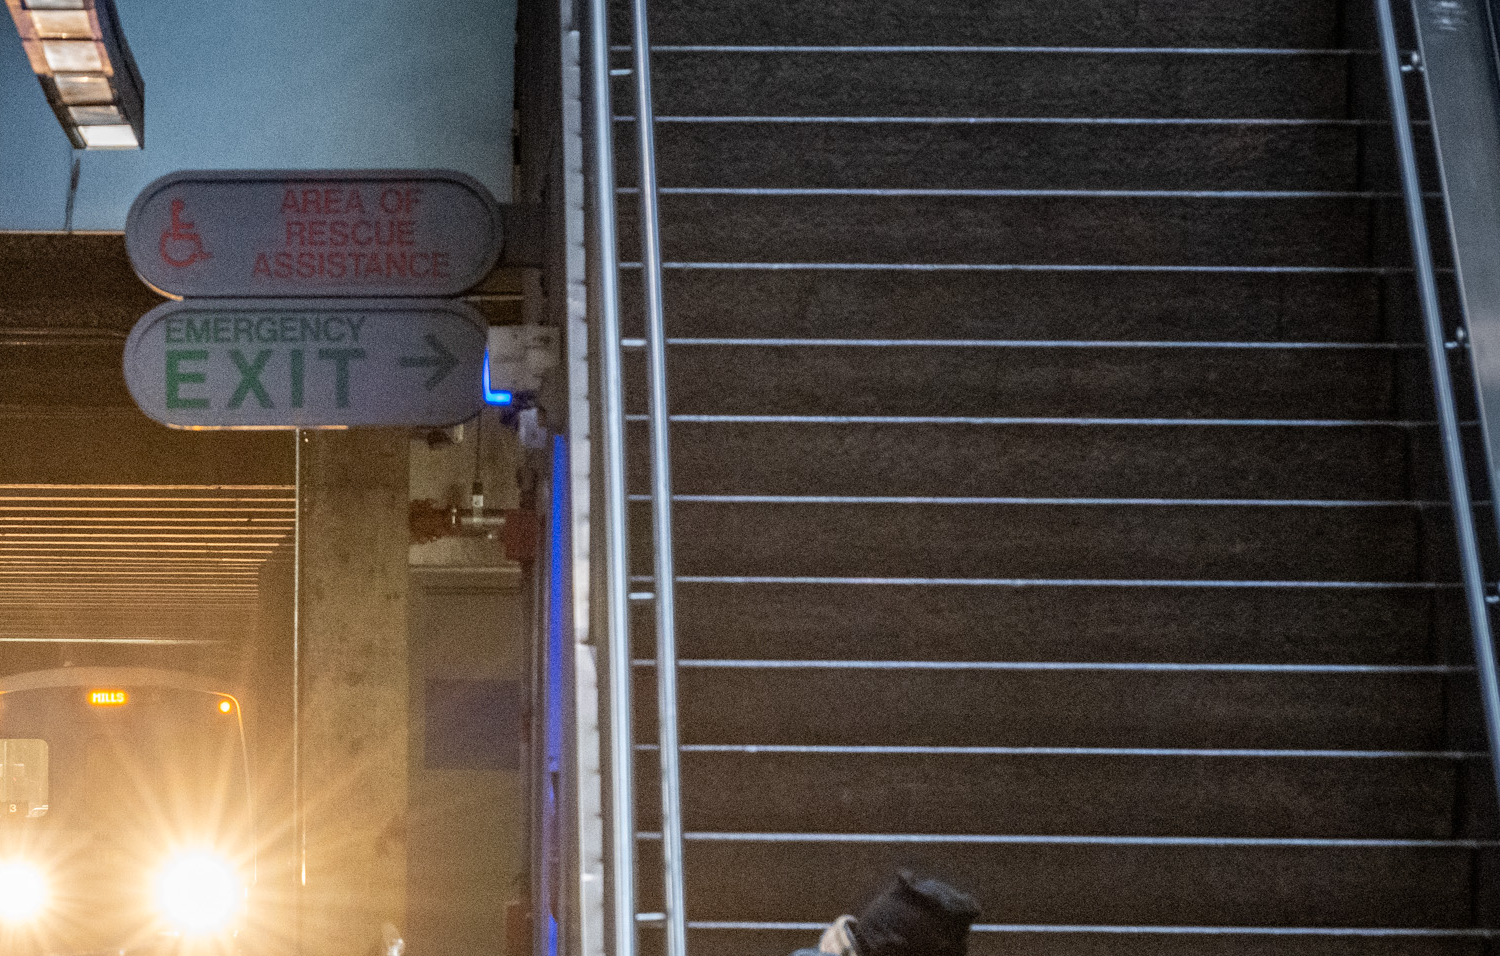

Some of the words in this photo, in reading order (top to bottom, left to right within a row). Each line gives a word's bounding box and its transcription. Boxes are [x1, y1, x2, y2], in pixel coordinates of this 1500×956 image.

[281, 188, 365, 214] AREA
[381, 188, 424, 214] OF
[285, 220, 416, 246] RESCUE
[253, 251, 451, 279] ASSISTANCE
[165, 315, 366, 343] EMERGENCY
[165, 349, 366, 409] EXIT
[92, 692, 125, 703] MILLS
